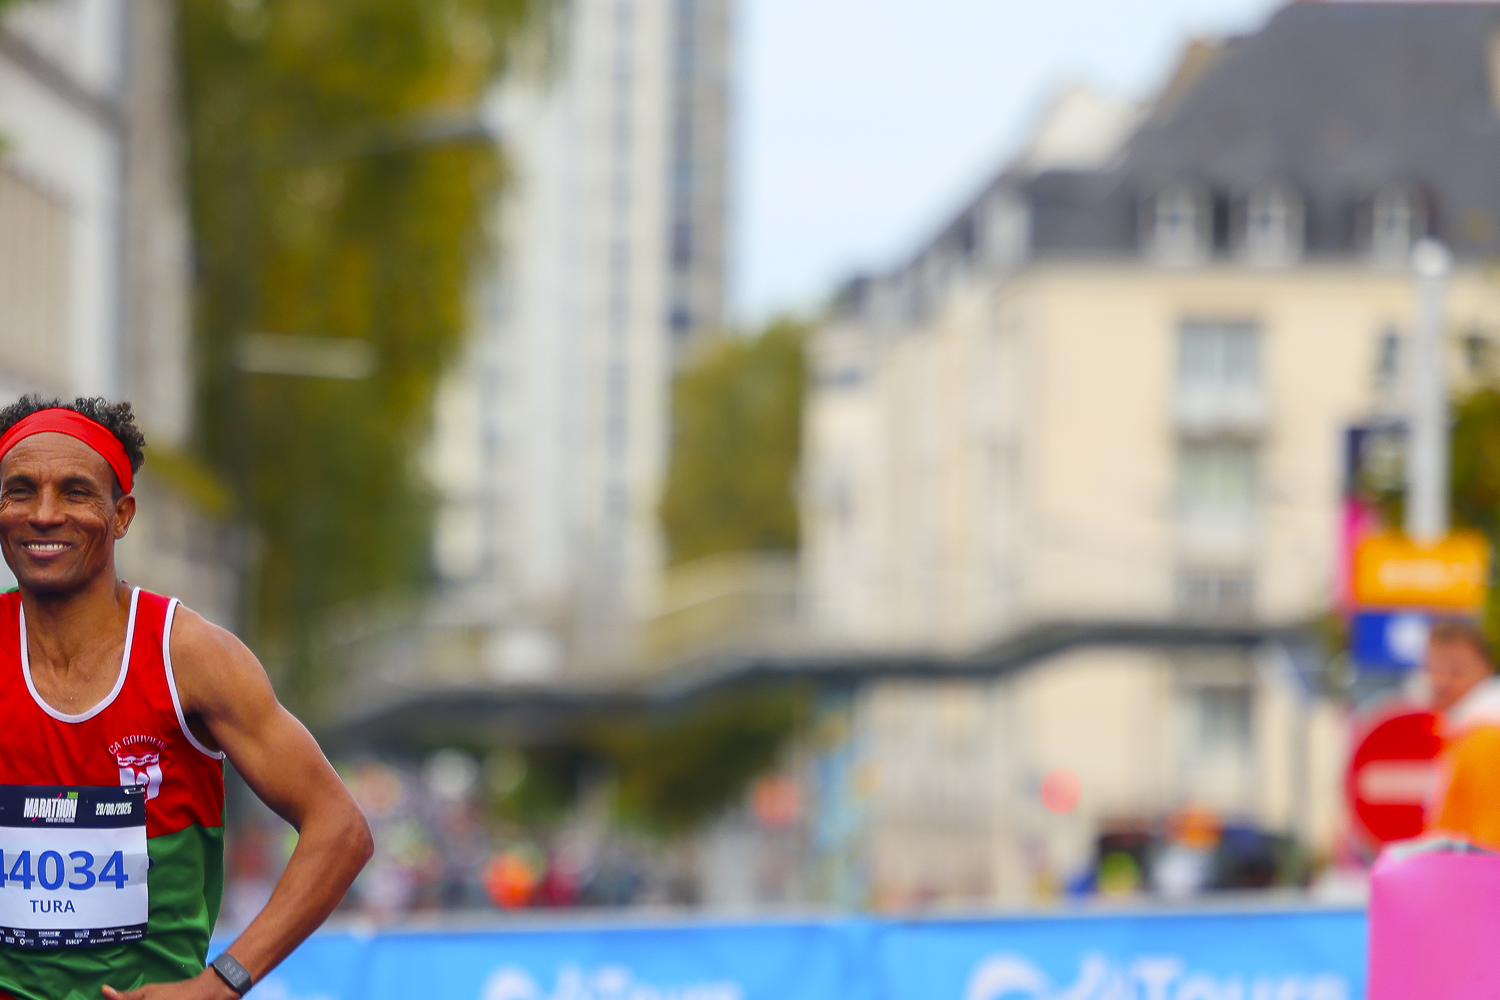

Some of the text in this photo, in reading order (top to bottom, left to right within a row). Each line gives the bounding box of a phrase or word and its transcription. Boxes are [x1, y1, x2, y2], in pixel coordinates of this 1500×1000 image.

[108, 741, 122, 755] CA
[23, 797, 78, 818] MARATHON
[29, 899, 76, 914] TURA
